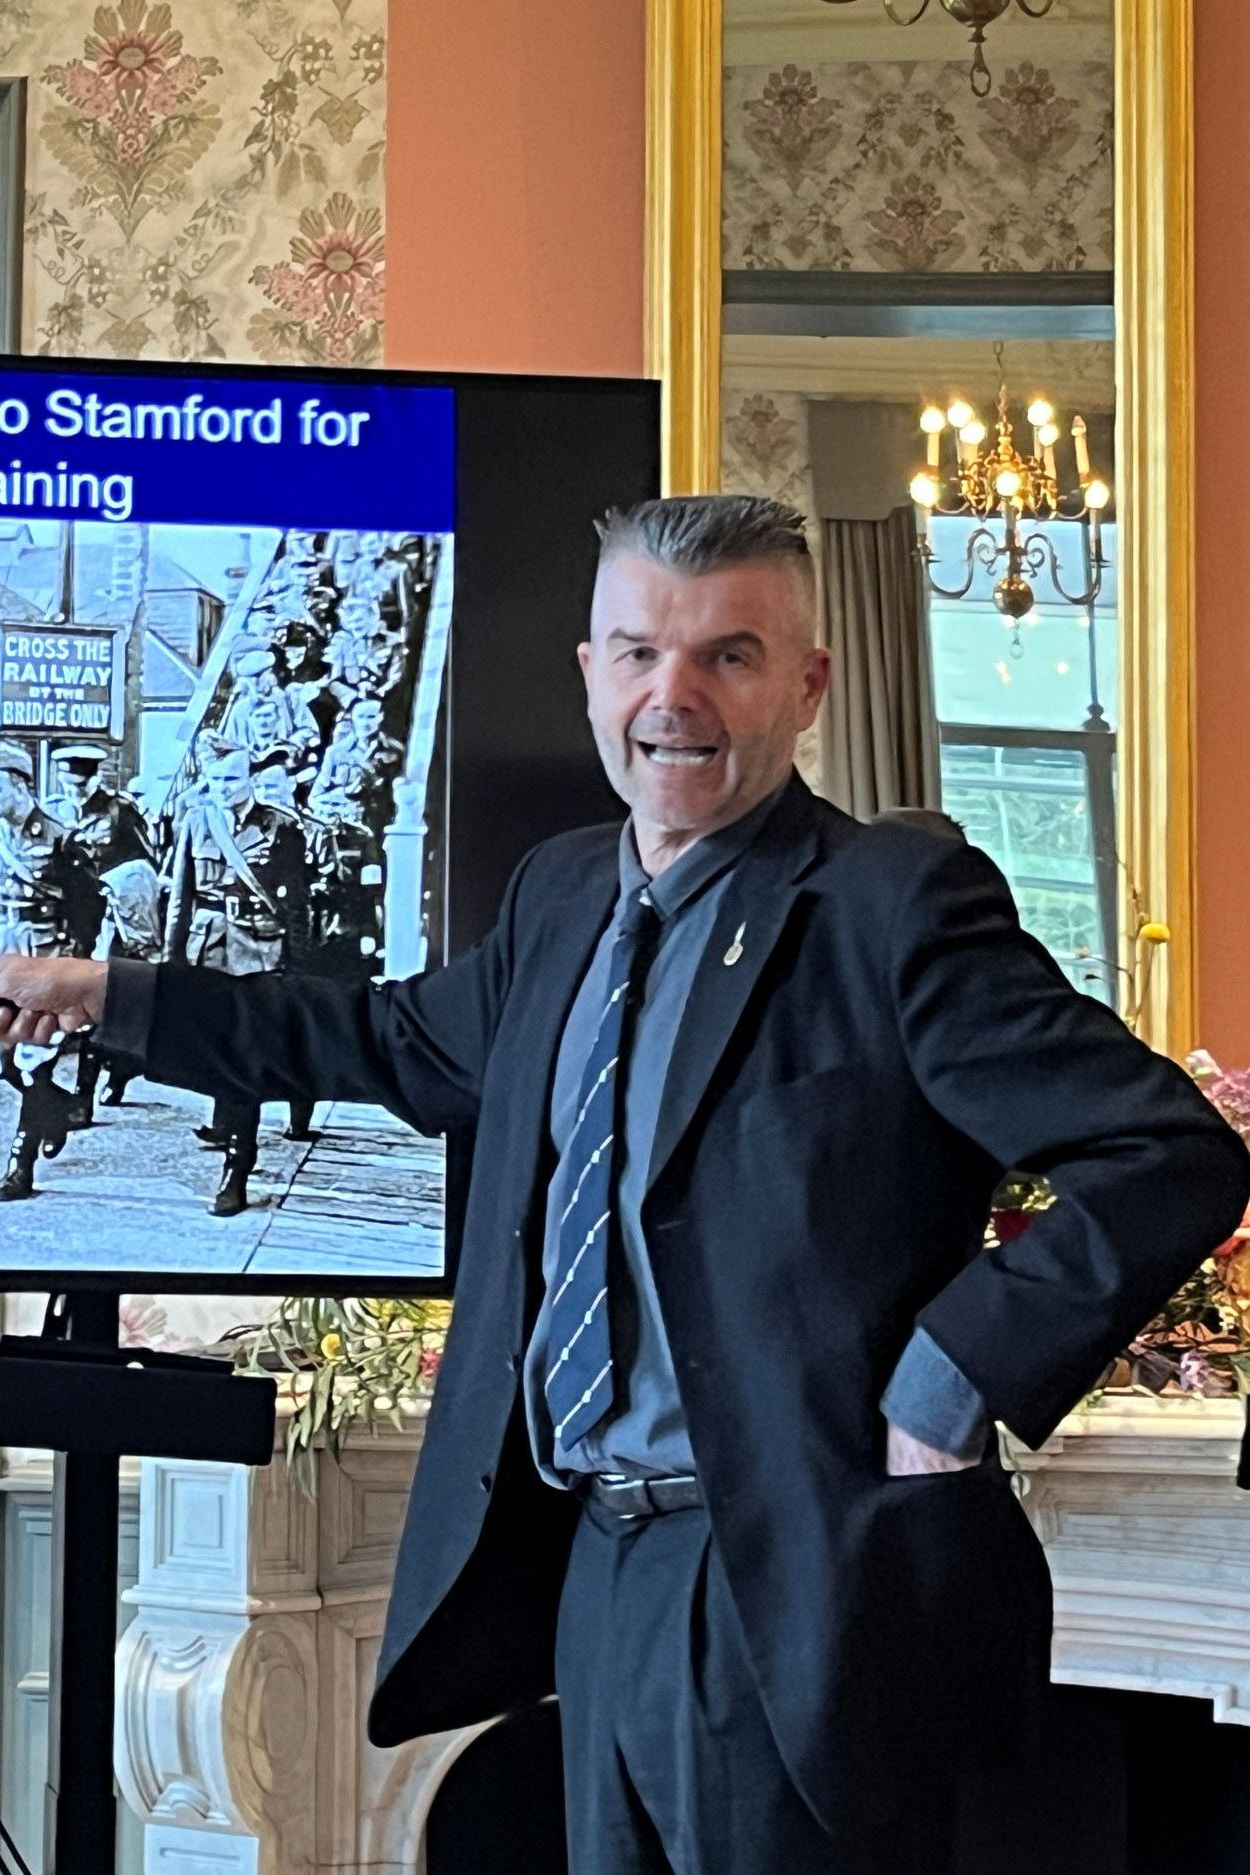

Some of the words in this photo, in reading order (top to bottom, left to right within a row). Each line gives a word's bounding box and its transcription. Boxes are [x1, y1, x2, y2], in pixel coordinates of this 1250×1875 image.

[45, 389, 282, 444] Stamford
[298, 399, 369, 446] for
[4, 636, 69, 660] CROSS
[73, 639, 111, 662] THE
[3, 662, 111, 686] RAILWAY
[3, 701, 67, 727] BRIDGE
[70, 703, 110, 728] ONLY
